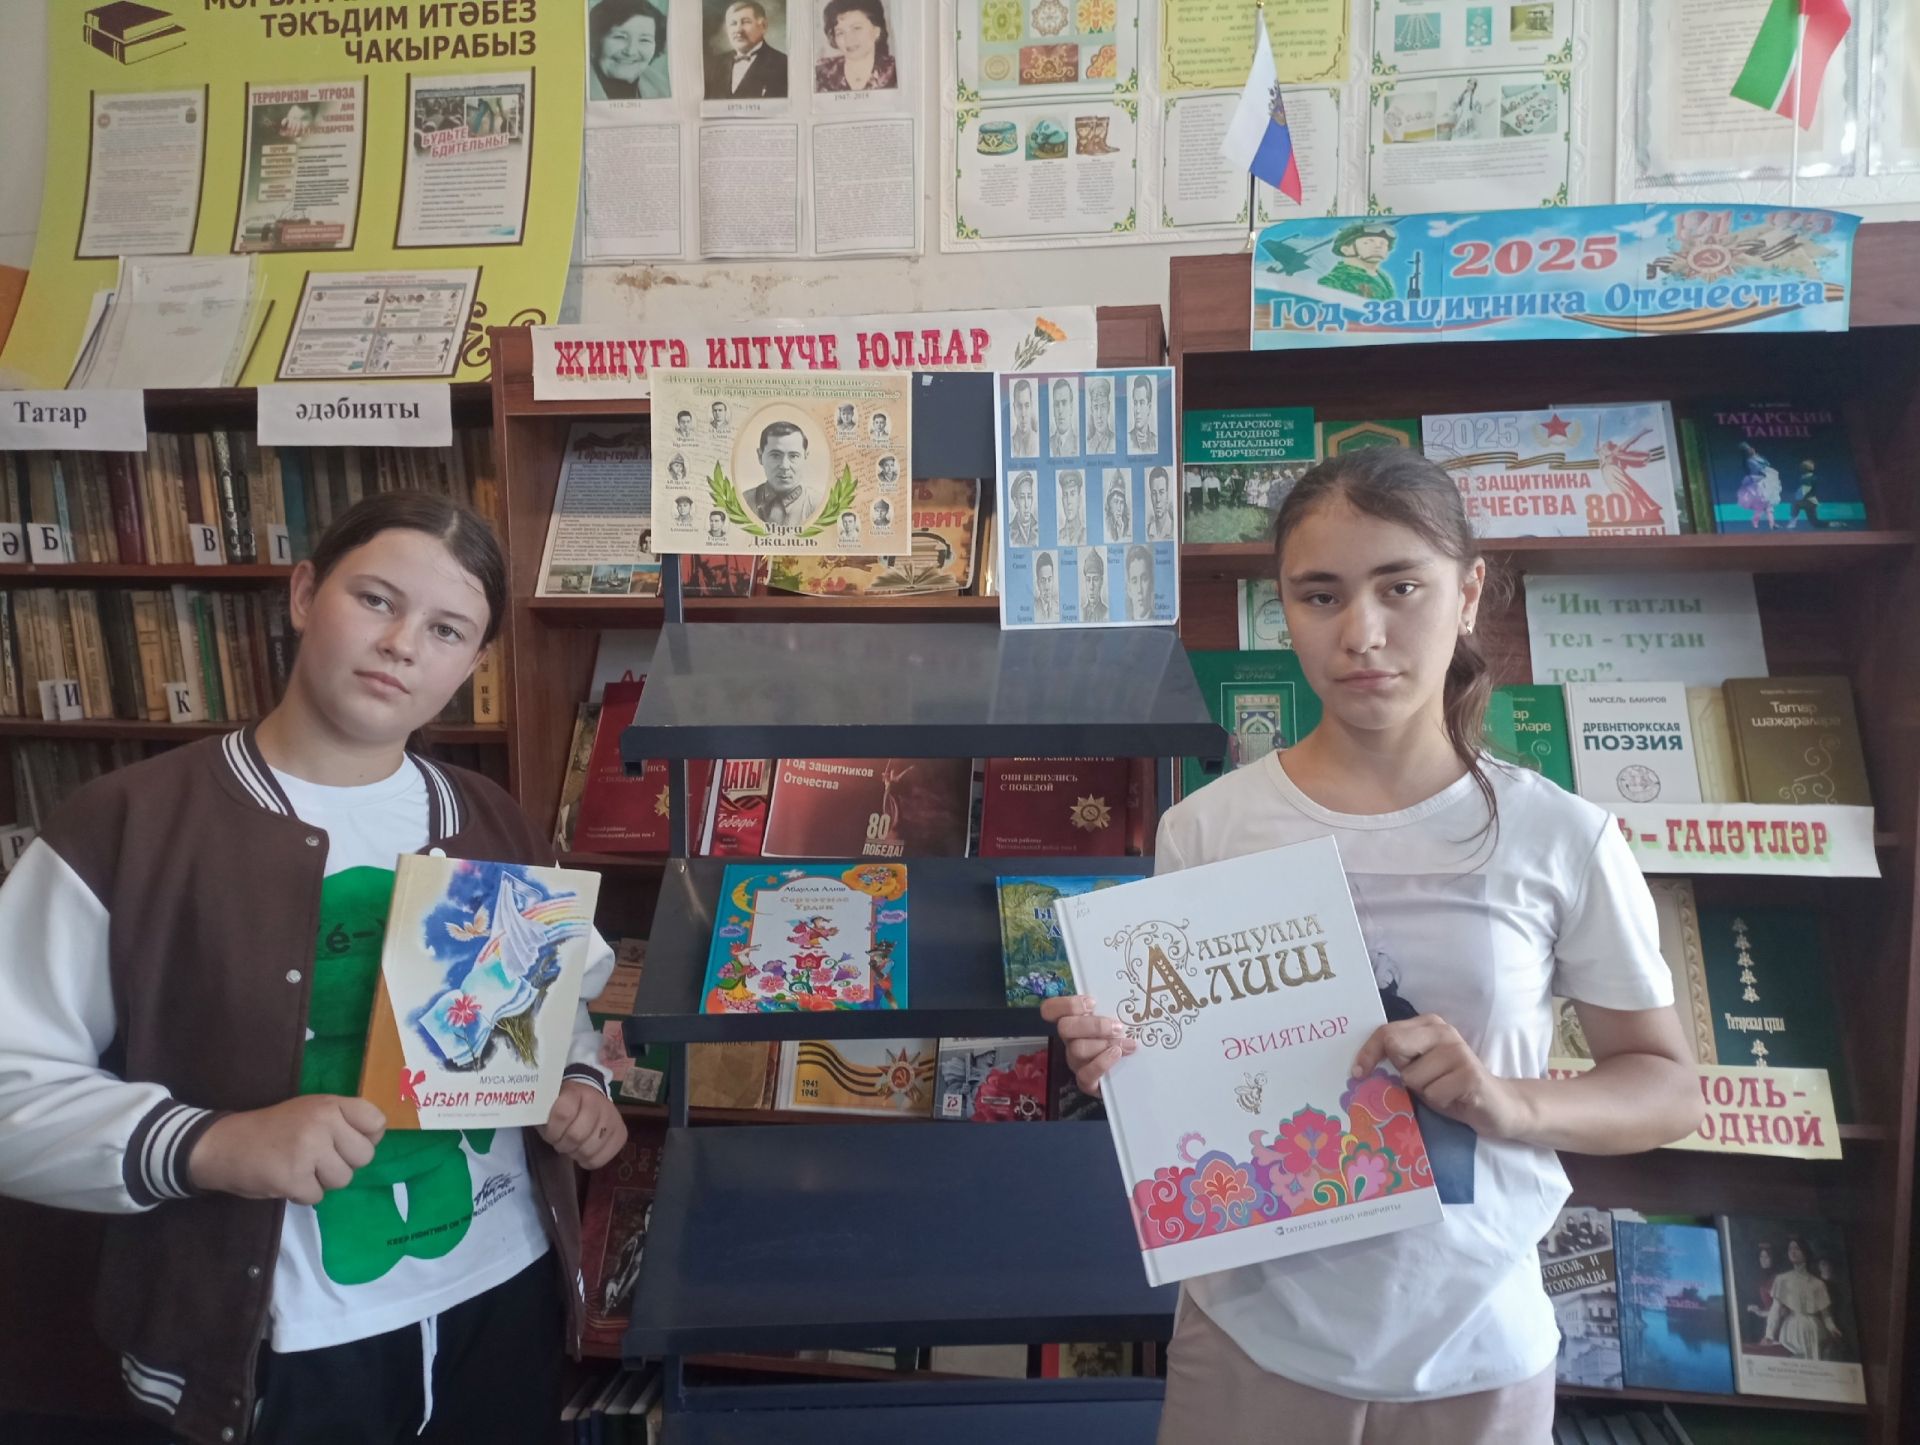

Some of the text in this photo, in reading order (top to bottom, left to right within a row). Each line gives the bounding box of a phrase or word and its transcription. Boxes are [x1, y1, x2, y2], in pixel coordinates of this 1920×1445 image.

[261, 0, 537, 38] ТӘКЪДИМ ИТӘБЕЗ
[345, 31, 537, 64] ЧАКЫРАБЫЗ
[252, 89, 309, 105] ТЕРРОРИЗМ
[318, 88, 355, 101] УГРОЗА
[422, 127, 468, 146] БУДЬТЕ
[431, 133, 509, 159] БДИТЕЛЬНЫ!
[1450, 234, 1621, 280] 2025
[1272, 279, 1826, 332] Год защитника Отечества
[706, 334, 838, 370] ИЛТҮЧЕ
[857, 329, 991, 368] ЮЛЛАР
[13, 401, 88, 428] Татар
[295, 397, 421, 423] әдәбияты
[1714, 410, 1833, 425] ТАТАРСКИЙ
[1213, 420, 1282, 430] ТАТАРСКОЕ
[1215, 430, 1280, 439] НАРОДНОЕ
[1430, 416, 1520, 450] 2025
[1742, 425, 1813, 439] ТАНЕЦ
[1202, 439, 1294, 449] МУЗЫКАЛЬНОЕ
[1210, 448, 1285, 458] ТВОРЧЕСТВО
[1475, 472, 1591, 491] ЗАЩИТНИКА
[1586, 493, 1627, 523] 80
[41, 527, 59, 551] Б
[763, 523, 803, 536] Муса
[202, 527, 216, 552] В
[276, 533, 289, 560] Г
[749, 537, 818, 548] Джалиль
[1608, 594, 1701, 615] татлы
[1545, 629, 1594, 648] тел
[1621, 630, 1706, 654] туган
[65, 682, 82, 707] И
[175, 688, 191, 715] К
[1589, 696, 1667, 704] МАРСЕЛЬ БАКИРОВ
[1583, 722, 1680, 733] ДРЕВНЕТЮРКСКАЯ
[1584, 735, 1684, 751] ПОЭЗИЯ
[808, 762, 874, 778] защитников
[1000, 774, 1078, 783] ОНИ ВЕРНУЛИСЬ
[784, 772, 839, 790] Отечества
[1009, 782, 1054, 792] ПОБЕДОЙ
[866, 813, 891, 840] 80
[10, 835, 25, 858] Р
[1666, 819, 1829, 856] ГАДӘТЛӘР
[862, 843, 904, 858] ПОБЕДА!
[1196, 914, 1325, 963] АБДУЛЛА
[1222, 1015, 1349, 1062] ӘКИЯТЛӘР
[400, 1068, 535, 1111] КЫЗЫЛ РОМАШКА
[480, 1075, 505, 1085] МУСА
[801, 1079, 819, 1089] 1941
[801, 1088, 819, 1098] 1945
[947, 1096, 958, 1107] 75
[1285, 1219, 1328, 1234] ТАТАРСТАН
